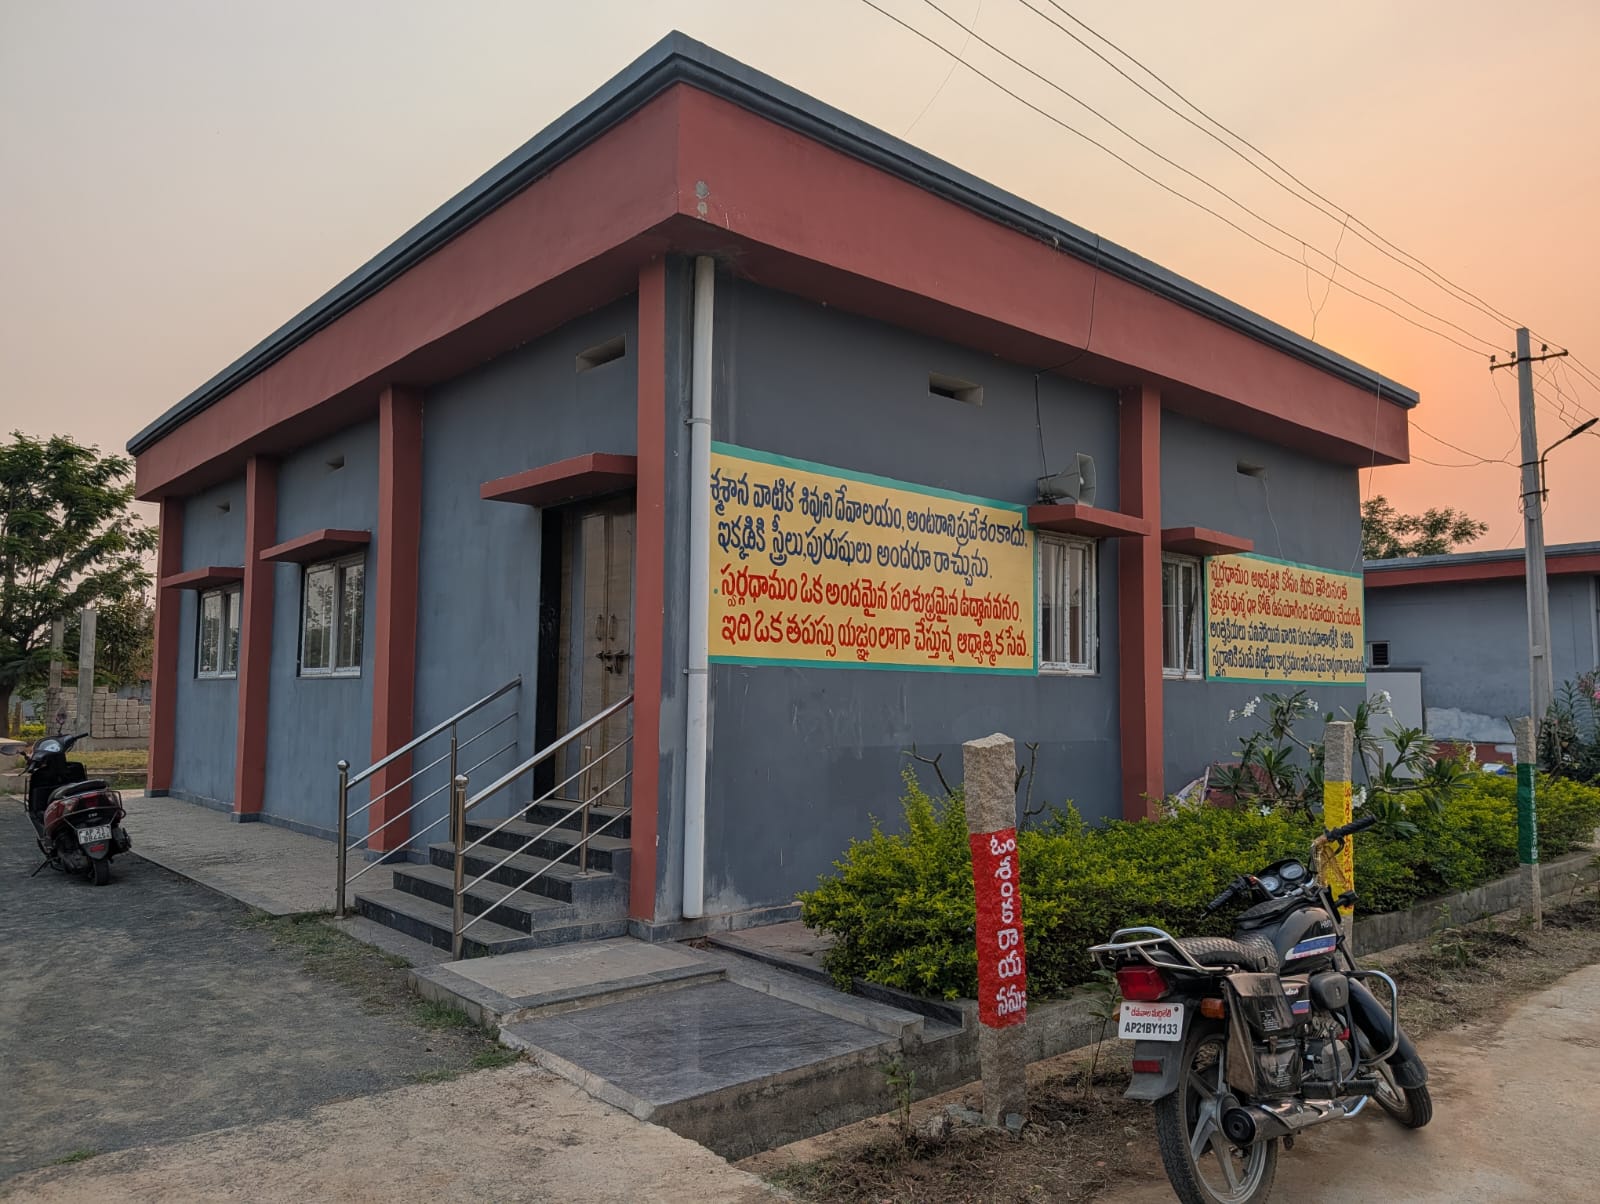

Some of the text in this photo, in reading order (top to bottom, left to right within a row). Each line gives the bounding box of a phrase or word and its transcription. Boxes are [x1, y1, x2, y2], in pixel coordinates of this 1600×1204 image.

[753, 478, 796, 512] వాటిక
[799, 486, 833, 524] శివుని
[877, 540, 931, 571] అందరూ
[720, 563, 798, 607] స్వర్గధామం
[825, 578, 888, 618] అందమైన
[891, 582, 958, 623] పరిశుభ్రమైన
[721, 613, 751, 645] ఇది
[786, 613, 837, 657] తపస్సు
[914, 618, 955, 662] చేస్తున్న
[1124, 1021, 1178, 1035] AP21BY1133
